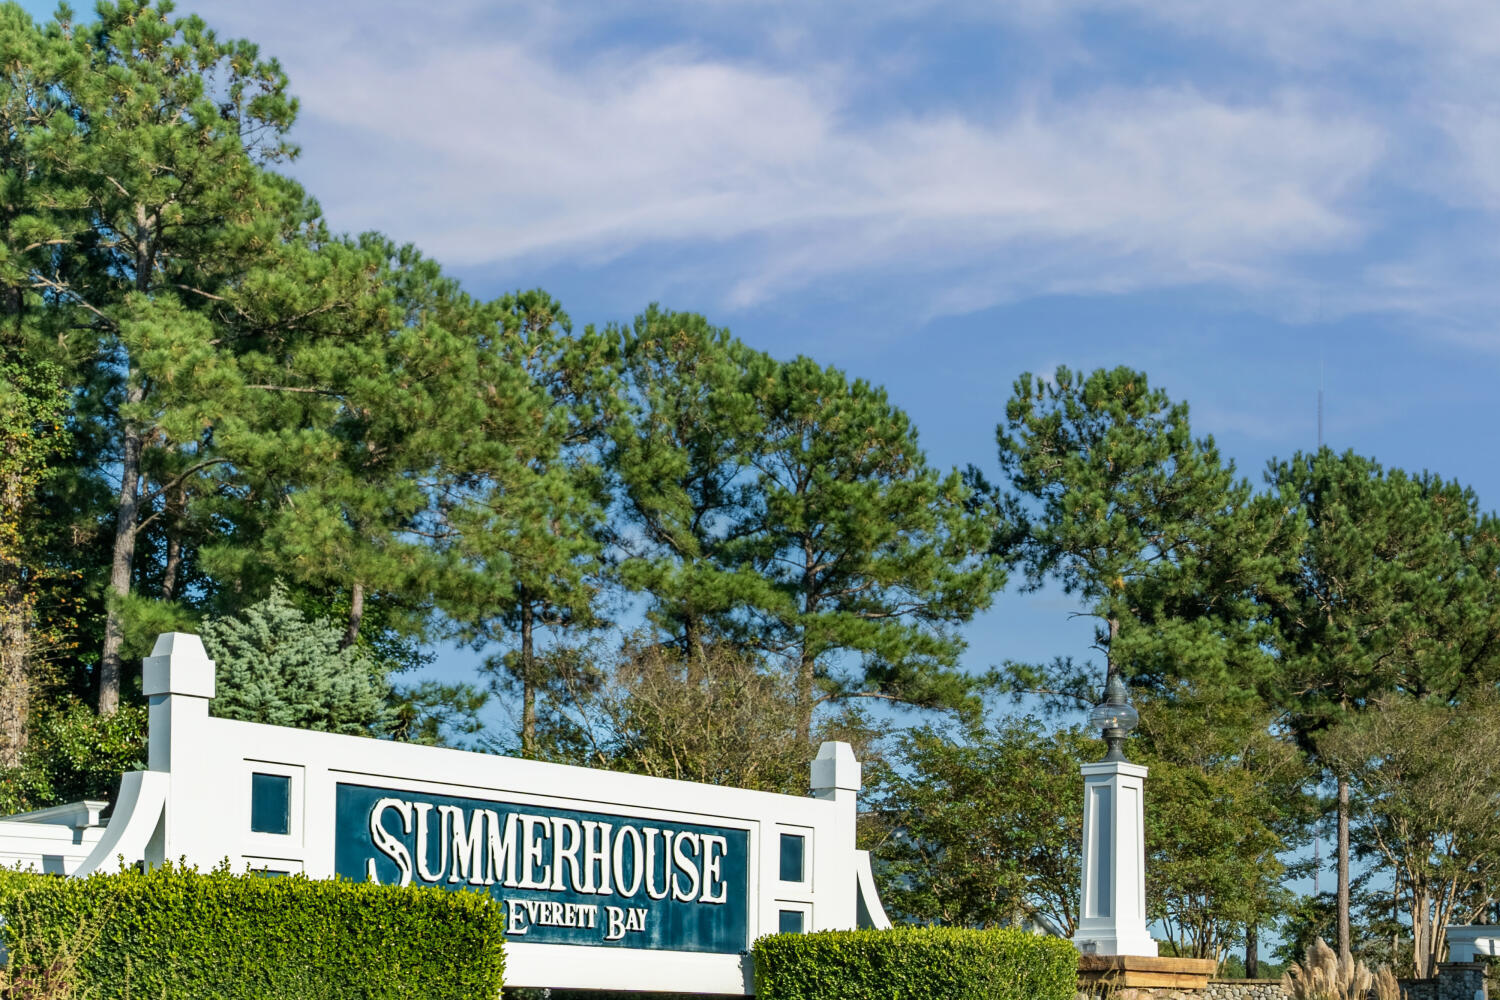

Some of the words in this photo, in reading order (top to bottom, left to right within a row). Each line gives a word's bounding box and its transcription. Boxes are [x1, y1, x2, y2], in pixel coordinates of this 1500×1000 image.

[368, 797, 728, 904] SUMMERHOUSE
[505, 899, 598, 935] EVERETT
[604, 906, 649, 940] BAY
